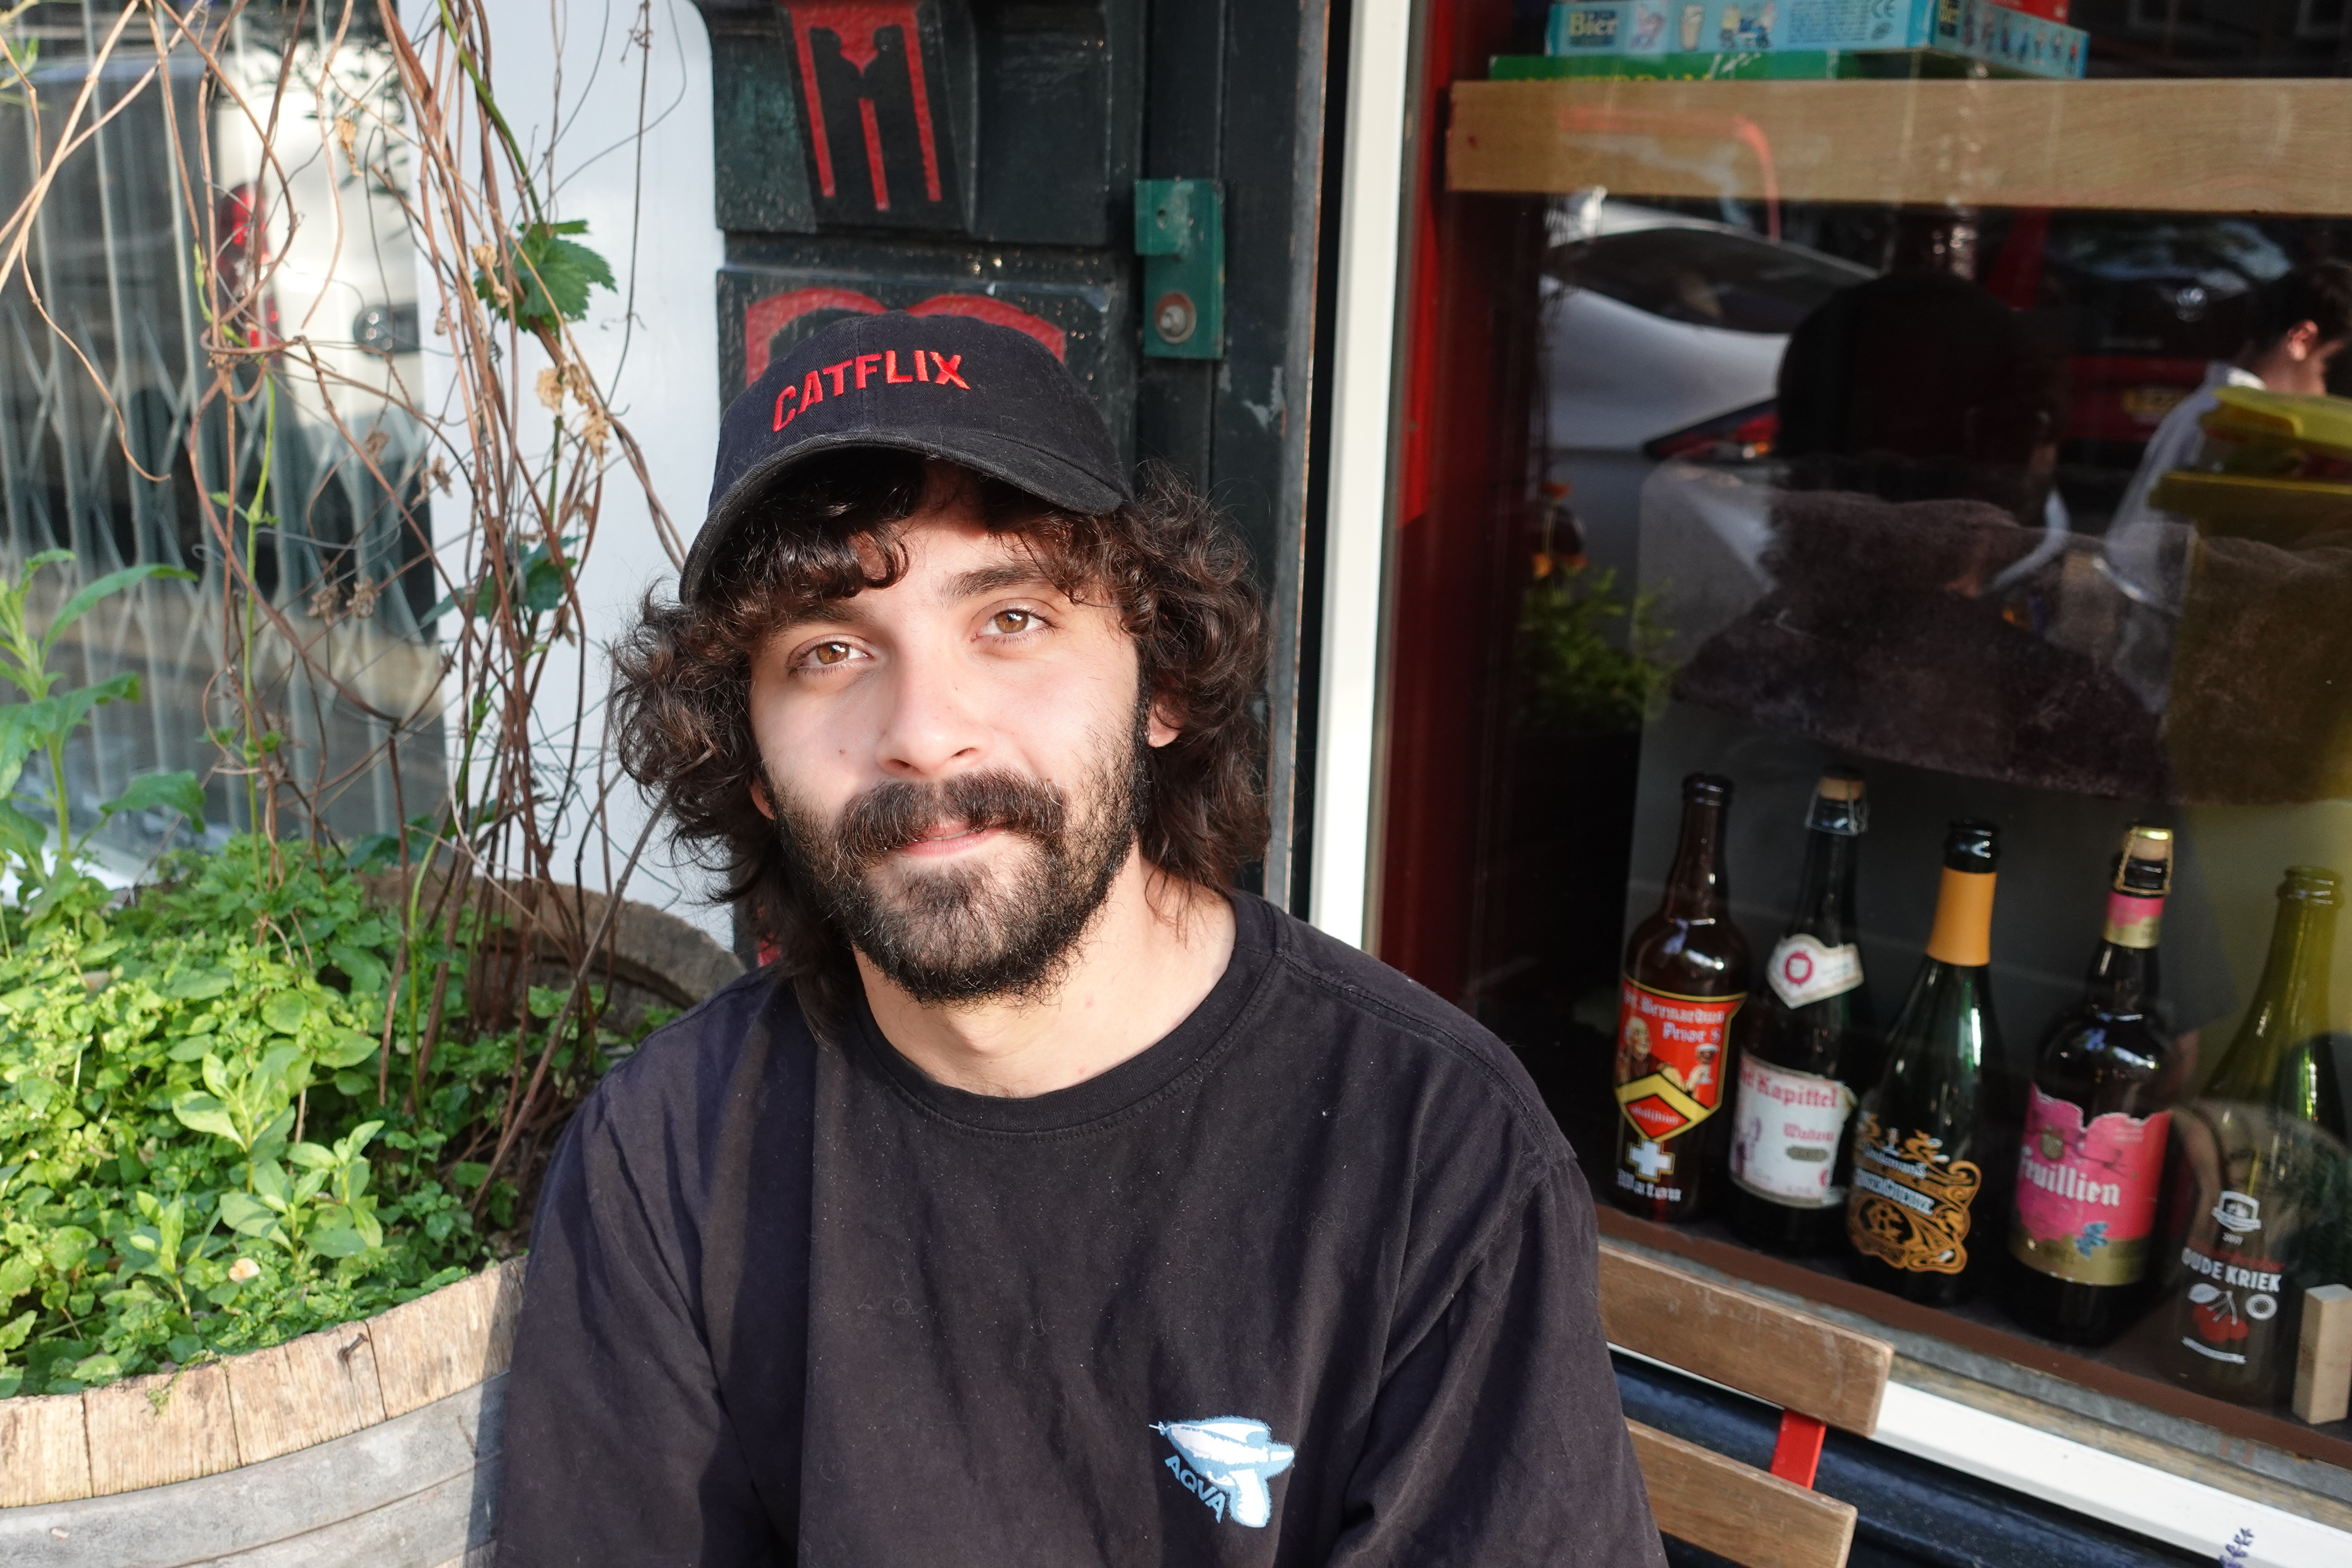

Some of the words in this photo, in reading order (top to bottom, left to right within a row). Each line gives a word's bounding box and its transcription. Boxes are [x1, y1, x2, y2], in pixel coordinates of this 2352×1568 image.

[1571, 12, 1617, 36] Bier
[772, 350, 971, 432] CATFLIX
[1662, 1021, 1707, 1043] Prior
[1758, 1075, 1837, 1108] Kapittel
[2181, 1247, 2224, 1280] OUDE
[2224, 1264, 2282, 1293] KRIEK
